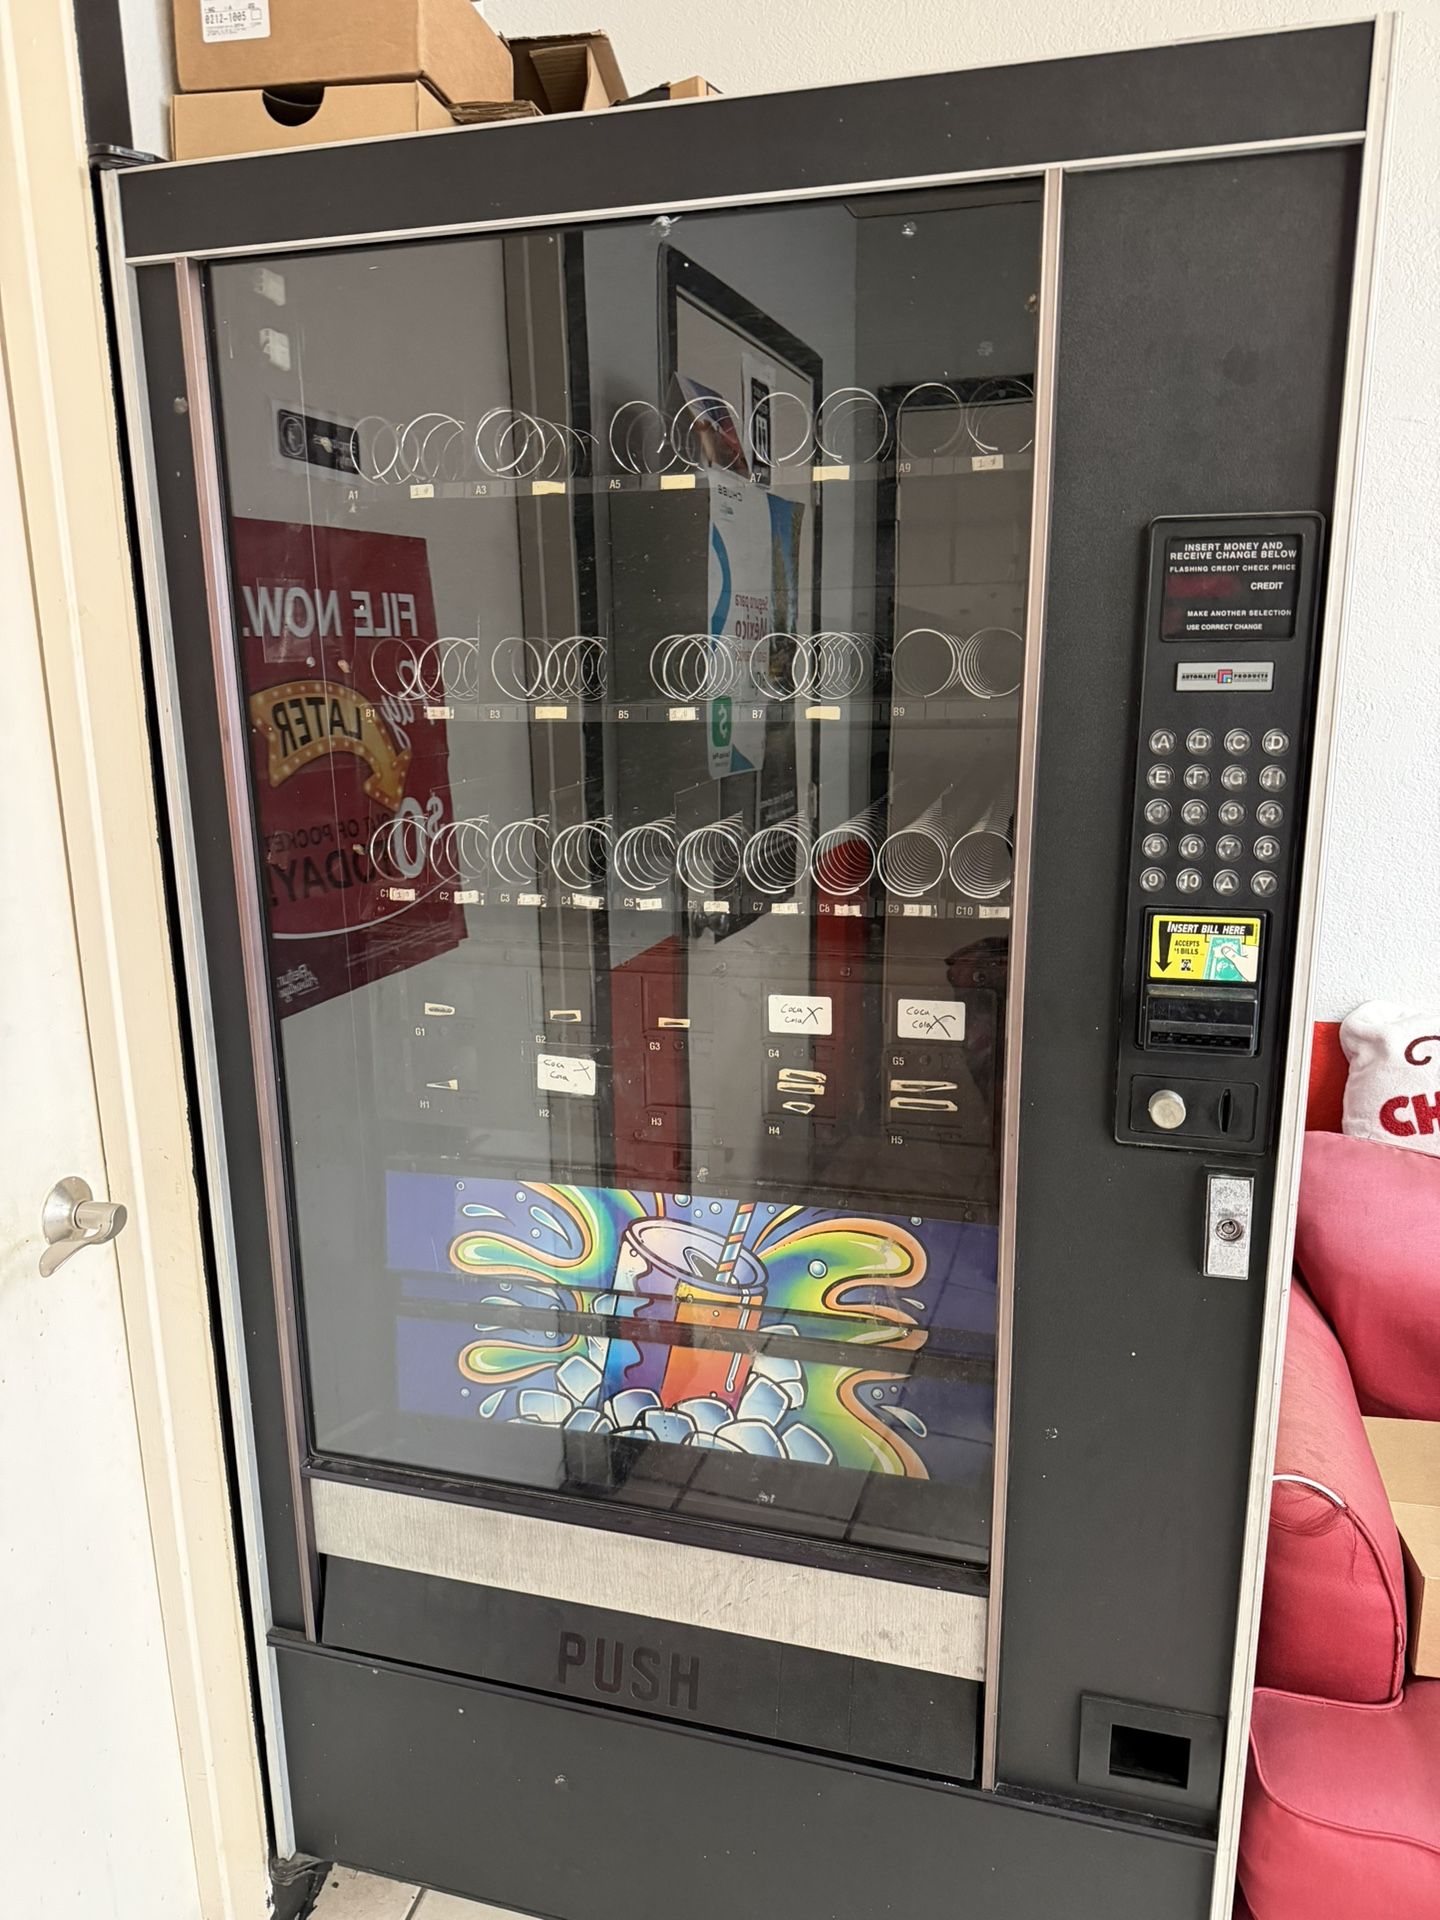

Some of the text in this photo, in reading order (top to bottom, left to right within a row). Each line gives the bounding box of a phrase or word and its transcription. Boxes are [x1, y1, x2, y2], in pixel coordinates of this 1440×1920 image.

[750, 473, 761, 483] A7
[609, 479, 621, 489] A5
[348, 489, 359, 500] A1
[475, 485, 487, 495] A3
[1184, 541, 1283, 551] INSERT MONEY AND
[1170, 550, 1297, 560] RECEIVE CHANGE BELOW
[1250, 582, 1284, 590] CREDIT
[365, 708, 375, 718] B1
[490, 710, 500, 719] B3
[618, 710, 629, 719] B5
[752, 709, 763, 719] B7
[1157, 735, 1170, 749] A
[1233, 736, 1245, 749] C
[1270, 736, 1283, 750] D
[1155, 770, 1167, 784] E
[1229, 771, 1243, 784] G
[1190, 806, 1201, 819] 2
[1228, 806, 1238, 819] 3
[1265, 807, 1276, 820] 4
[1151, 839, 1273, 856] 5 6 7 8
[1148, 874, 1198, 888] 9 10
[380, 889, 389, 898] C1
[439, 891, 449, 900] C2
[624, 898, 634, 907] C5
[752, 902, 763, 911] C7
[819, 903, 830, 912] C8
[888, 904, 899, 914] C9
[955, 907, 973, 916] C10
[1167, 921, 1199, 933] INSERT
[1201, 924, 1220, 934] BILL
[1222, 925, 1246, 935] HERE
[780, 1003, 803, 1014] Coca
[906, 1006, 930, 1016] Coca
[784, 1014, 803, 1024] Cola
[912, 1019, 932, 1029] Cola
[649, 1042, 660, 1050] G3
[768, 1049, 779, 1057] G4
[893, 1057, 904, 1065] G5
[420, 1101, 429, 1109] H1
[539, 1109, 549, 1117] H2
[1379, 1091, 1440, 1137] CH
[651, 1118, 662, 1126] H3
[769, 1126, 780, 1135] H4
[891, 1135, 903, 1144] H5
[558, 1631, 700, 1711] PUSH
